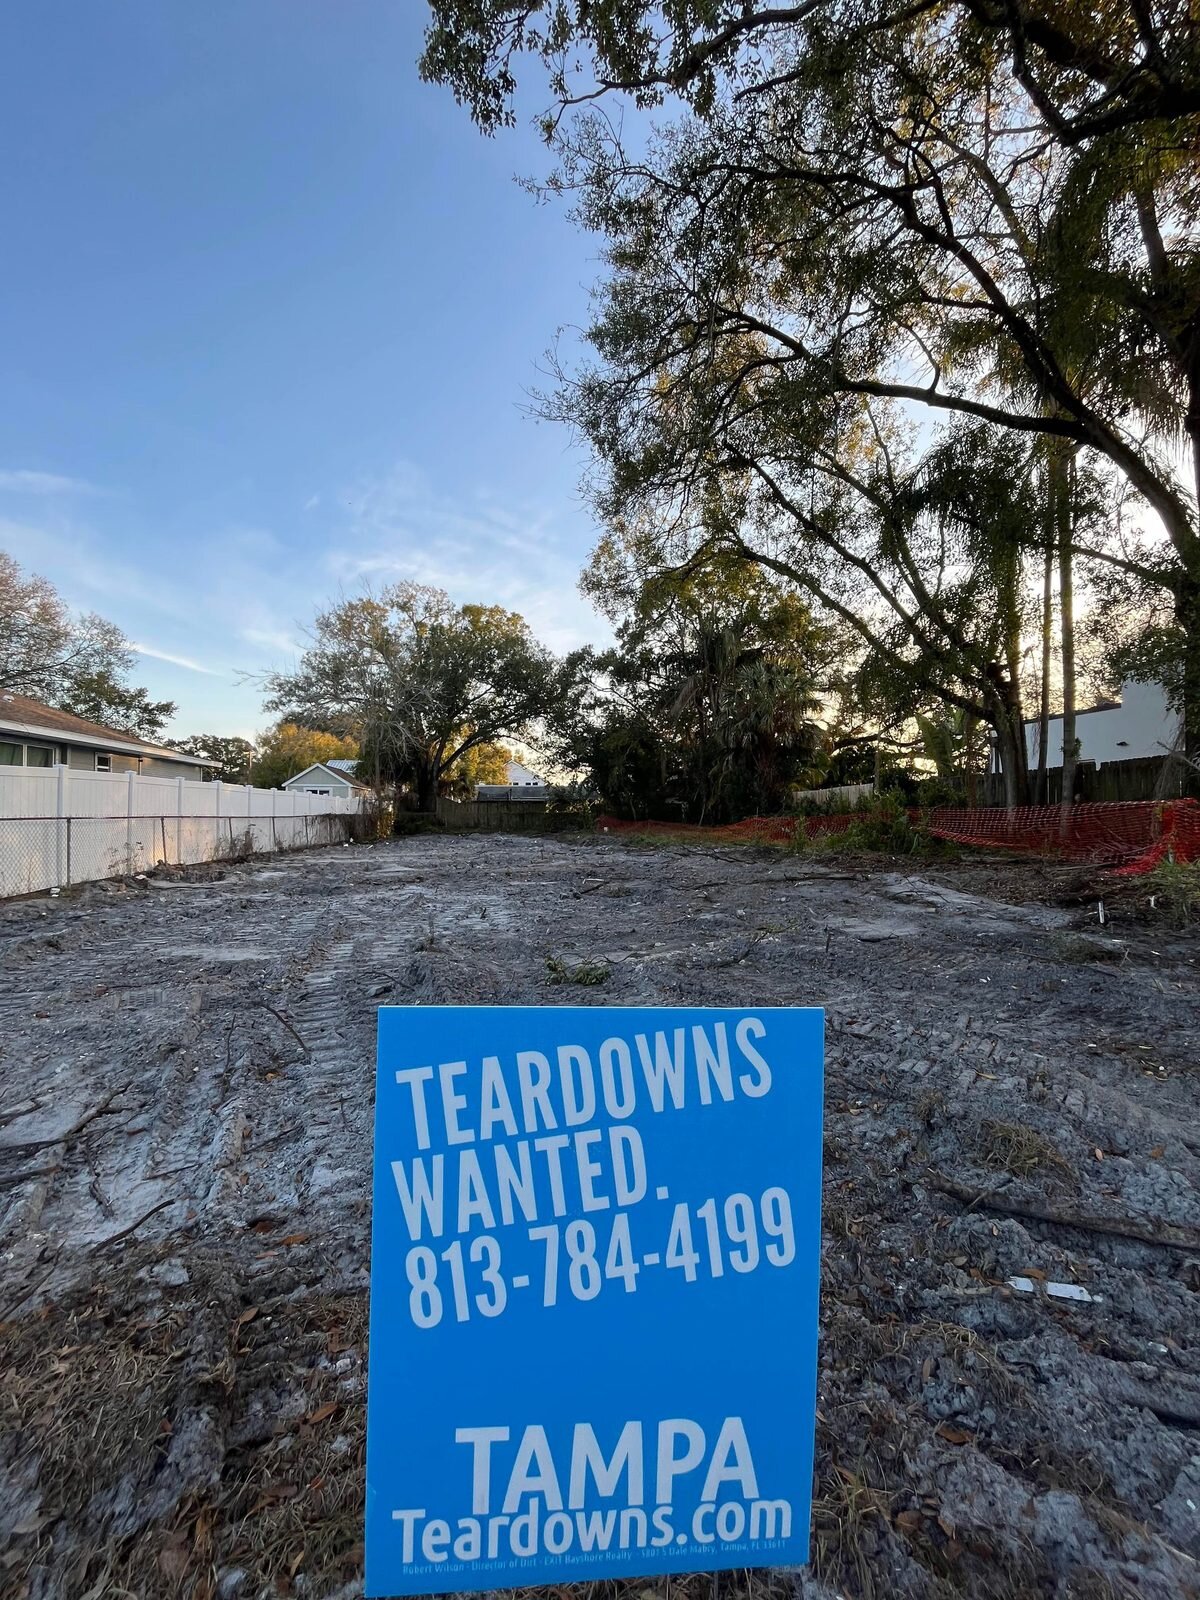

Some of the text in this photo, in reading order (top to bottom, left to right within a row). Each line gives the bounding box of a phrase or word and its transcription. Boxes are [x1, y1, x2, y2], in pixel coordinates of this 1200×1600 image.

[396, 1018, 772, 1150] TEARDOWNS
[391, 1126, 669, 1241] WANTED.
[406, 1188, 796, 1328] 813-784-4199
[456, 1418, 759, 1515] TAMPA
[393, 1498, 792, 1563] Teardowns.com
[402, 1563, 432, 1575] Robert
[434, 1561, 464, 1573] Wilson
[471, 1560, 506, 1572] Director
[509, 1557, 518, 1568] of
[565, 1552, 603, 1566] Bayshore
[605, 1549, 633, 1561] Realty
